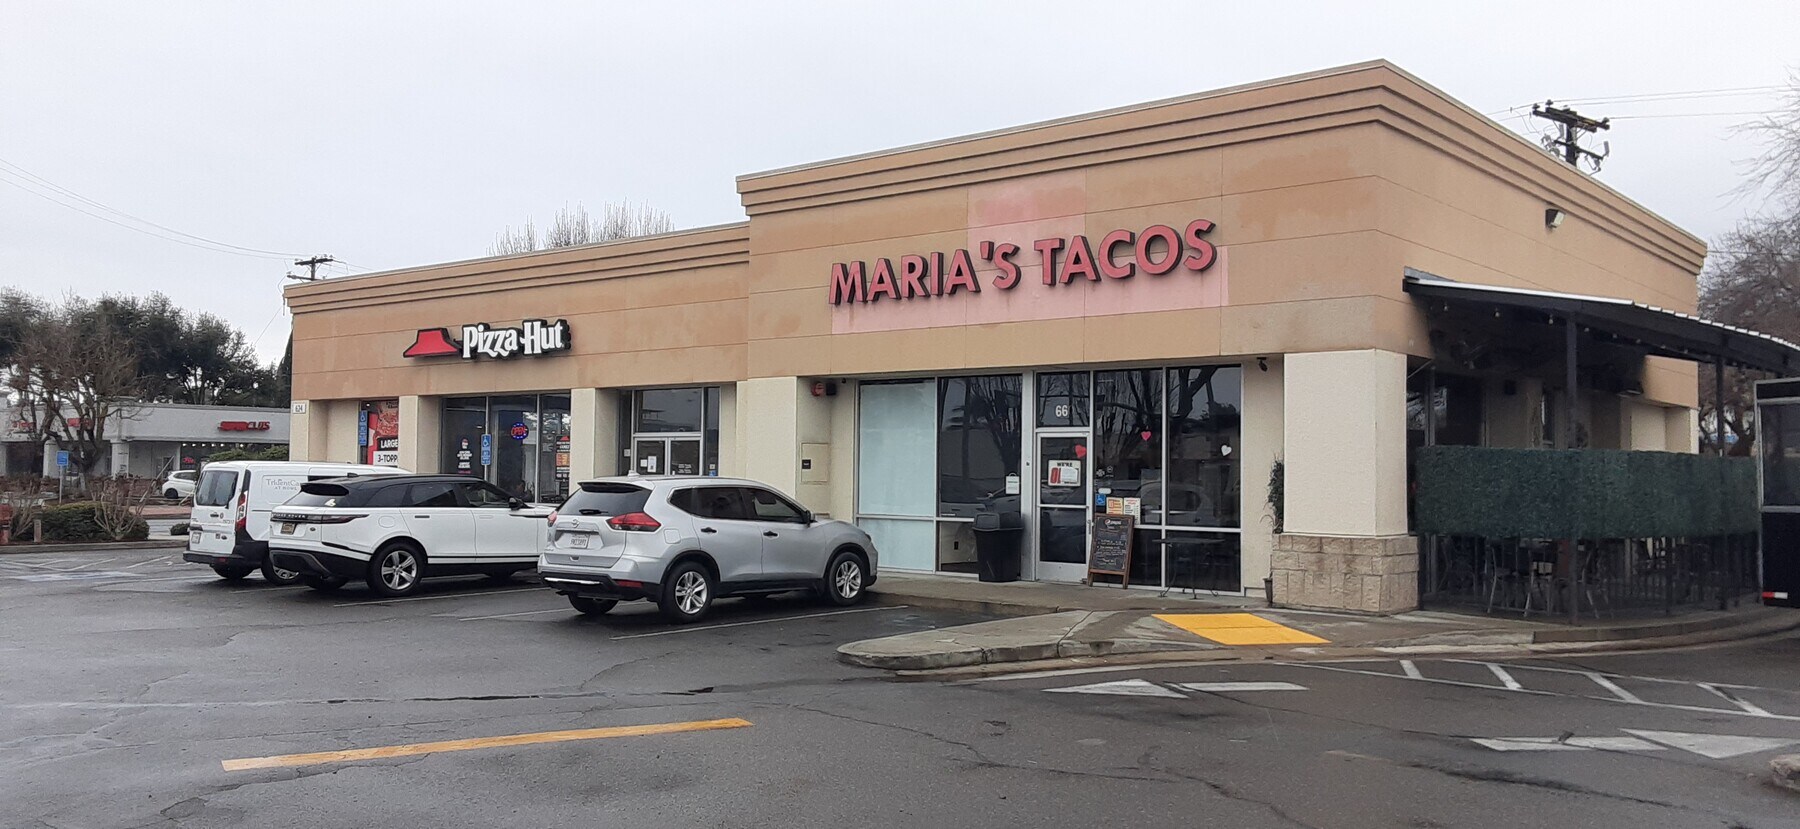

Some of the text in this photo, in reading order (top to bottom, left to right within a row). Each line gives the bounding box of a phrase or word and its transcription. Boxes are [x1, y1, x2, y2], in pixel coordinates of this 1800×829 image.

[829, 219, 1218, 305] MARIA'S TACOS
[462, 320, 565, 359] Pizza Hut
[381, 439, 398, 448] LARGE
[378, 454, 398, 463] 3-TOPP
